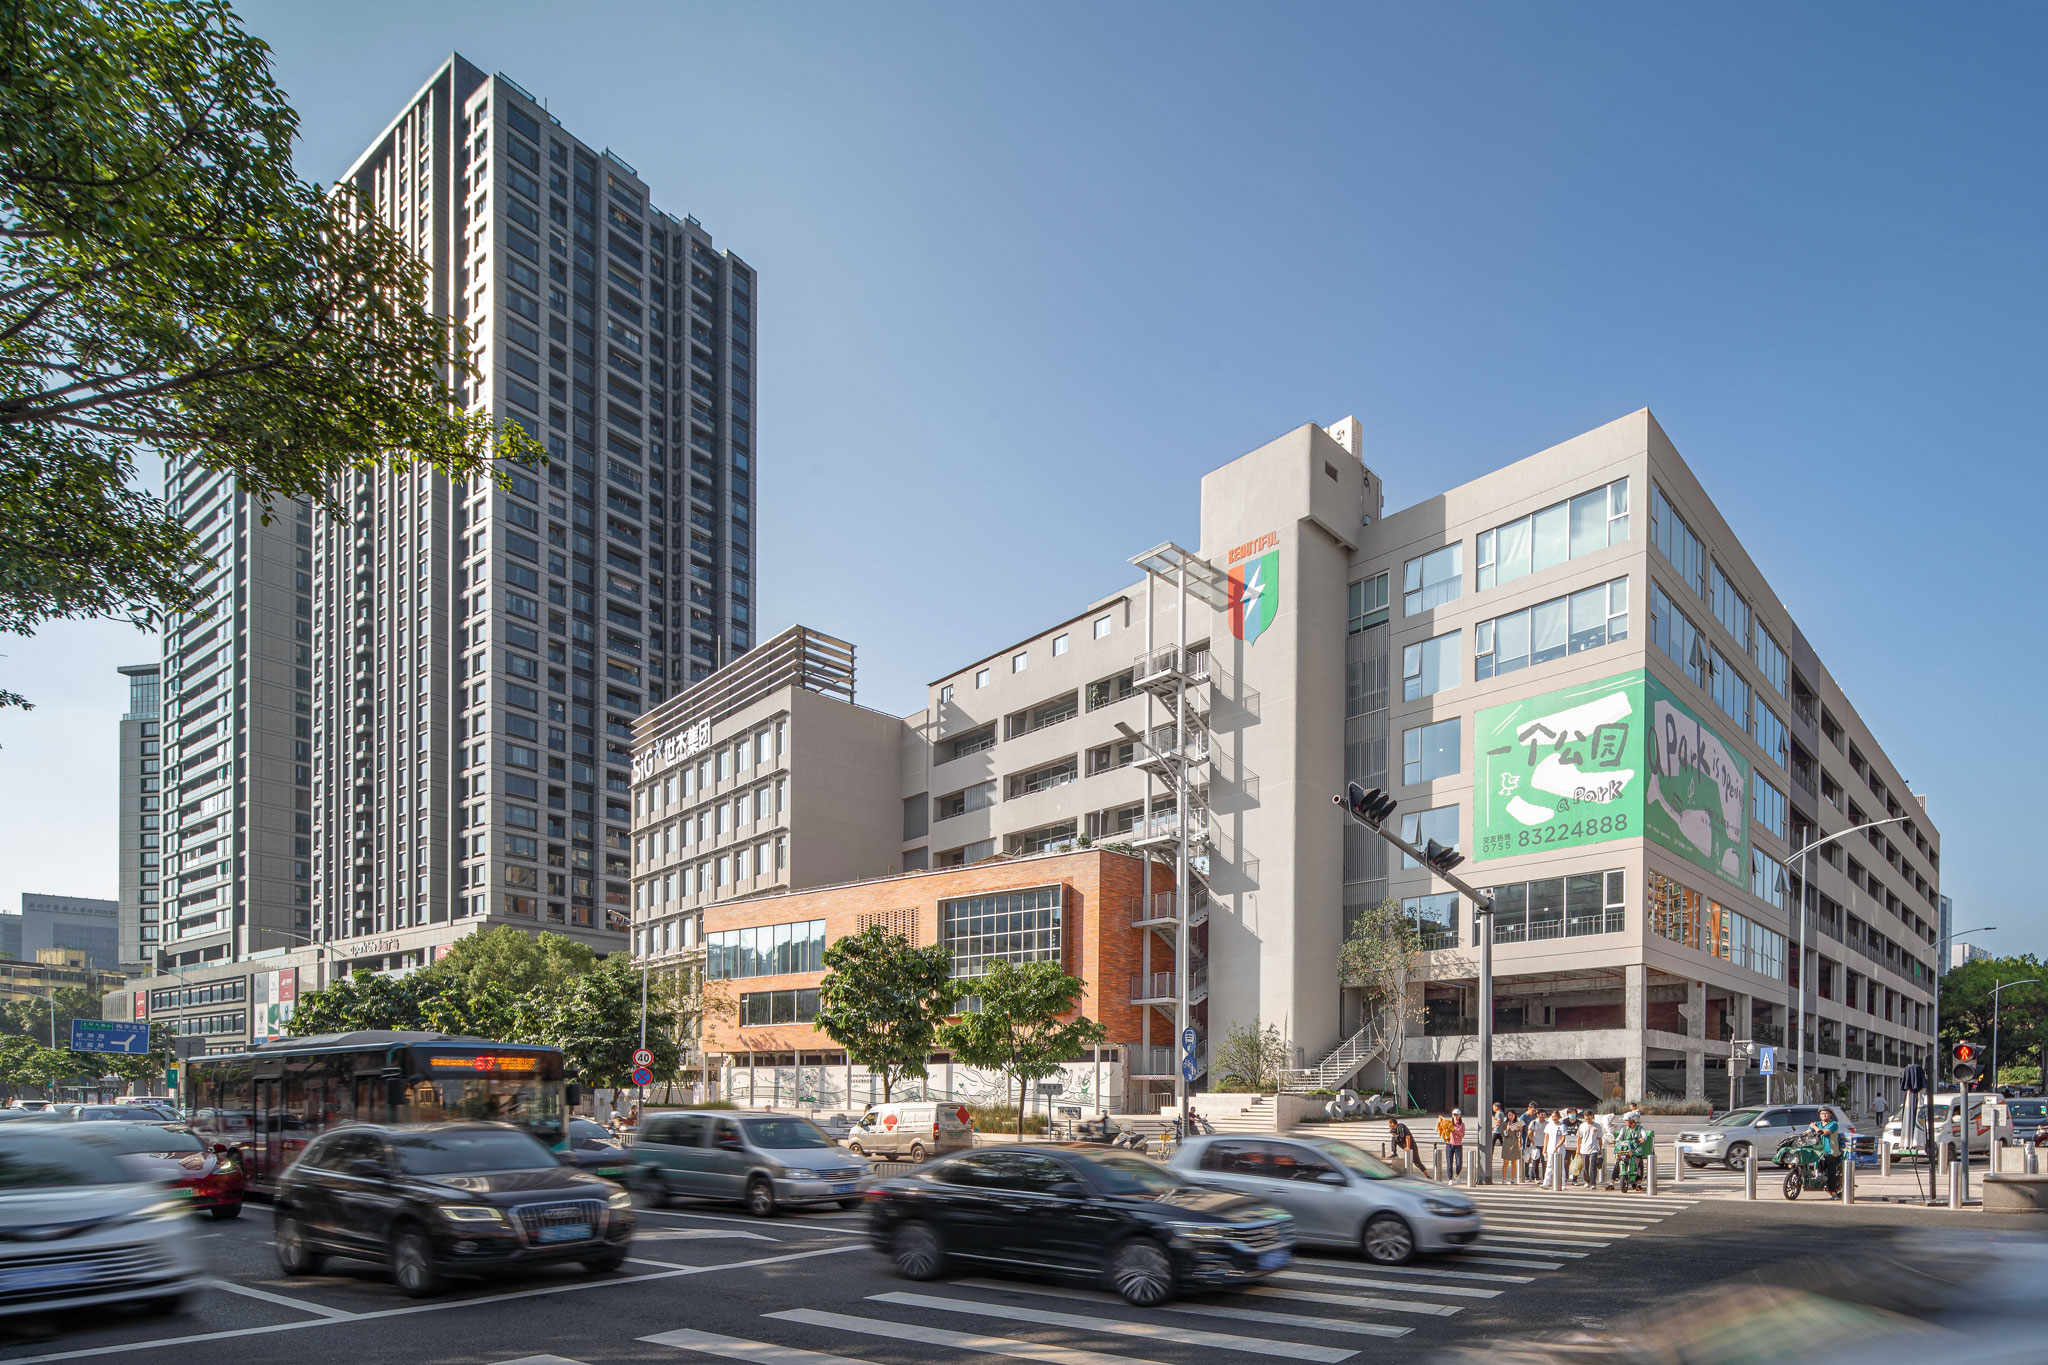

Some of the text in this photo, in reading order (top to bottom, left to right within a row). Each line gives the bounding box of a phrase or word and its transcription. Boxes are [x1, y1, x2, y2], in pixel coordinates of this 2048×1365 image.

[1228, 530, 1279, 564] BEAUTIFUL
[1486, 722, 1629, 767] 一个公园
[1647, 727, 1665, 778] a
[1665, 713, 1710, 784] Park
[1713, 748, 1719, 778] is
[1556, 798, 1570, 814] a
[1483, 841, 1511, 853] 0755
[1518, 813, 1628, 847] 83224888
[637, 1053, 650, 1062] 40
